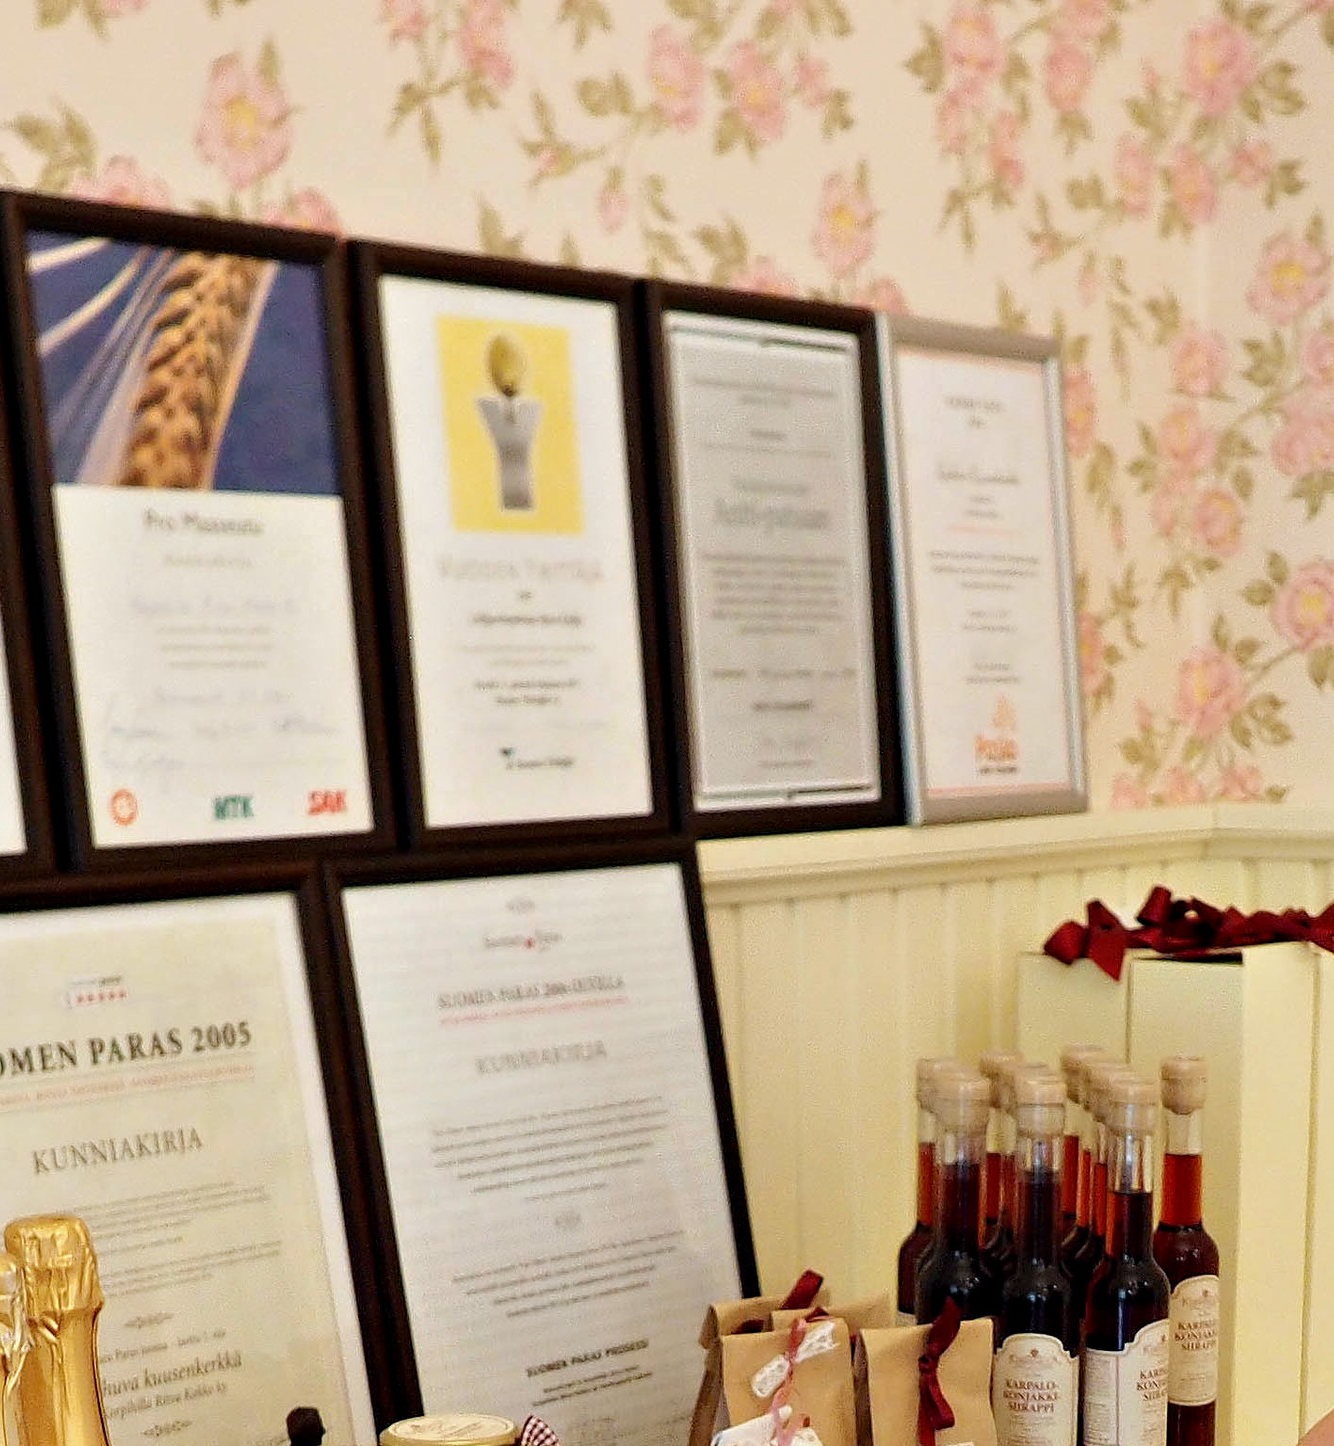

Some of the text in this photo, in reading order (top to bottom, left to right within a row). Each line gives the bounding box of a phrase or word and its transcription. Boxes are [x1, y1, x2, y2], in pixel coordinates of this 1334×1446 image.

[88, 1027, 184, 1067] PARAS
[191, 1020, 253, 1053] 2005
[32, 1126, 206, 1176] KUNNIAKIRJA
